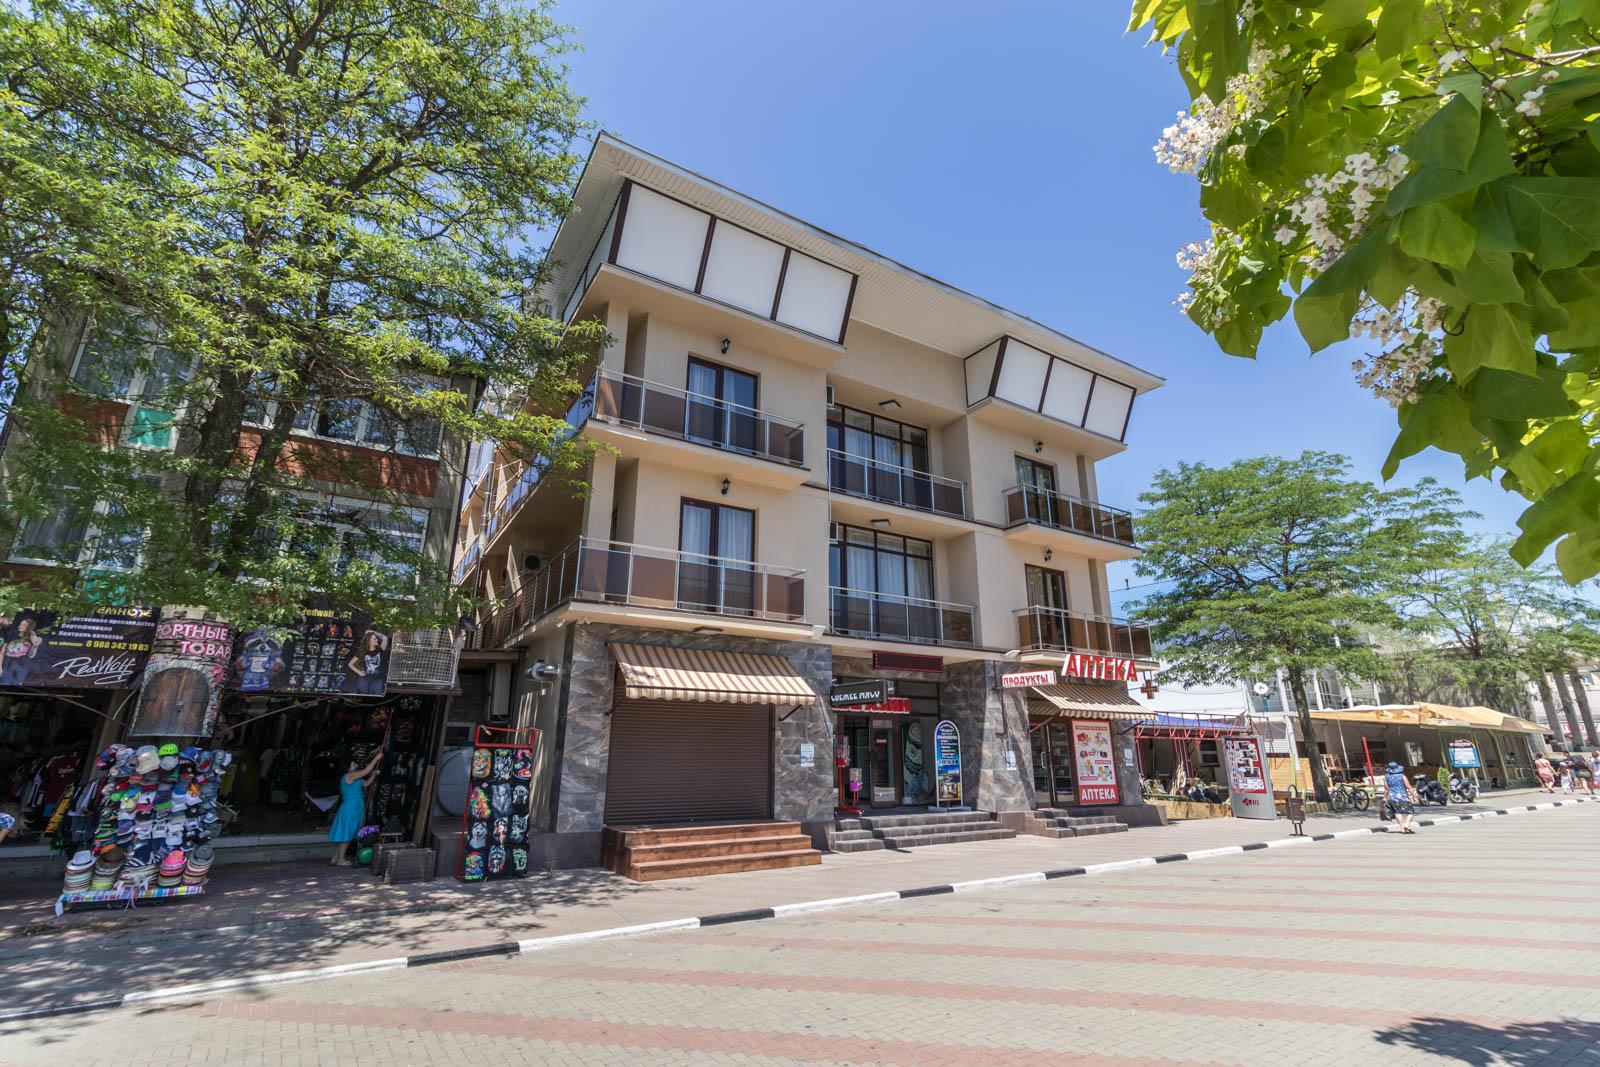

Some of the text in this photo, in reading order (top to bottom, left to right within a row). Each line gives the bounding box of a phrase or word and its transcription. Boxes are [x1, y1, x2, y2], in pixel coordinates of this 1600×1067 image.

[96, 606, 153, 618] ЕМНОТЕ
[1061, 653, 1138, 681] АПТЕКА
[1003, 673, 1048, 687] ПРОДУКТЫ
[1081, 788, 1116, 801] АПТЕКА
